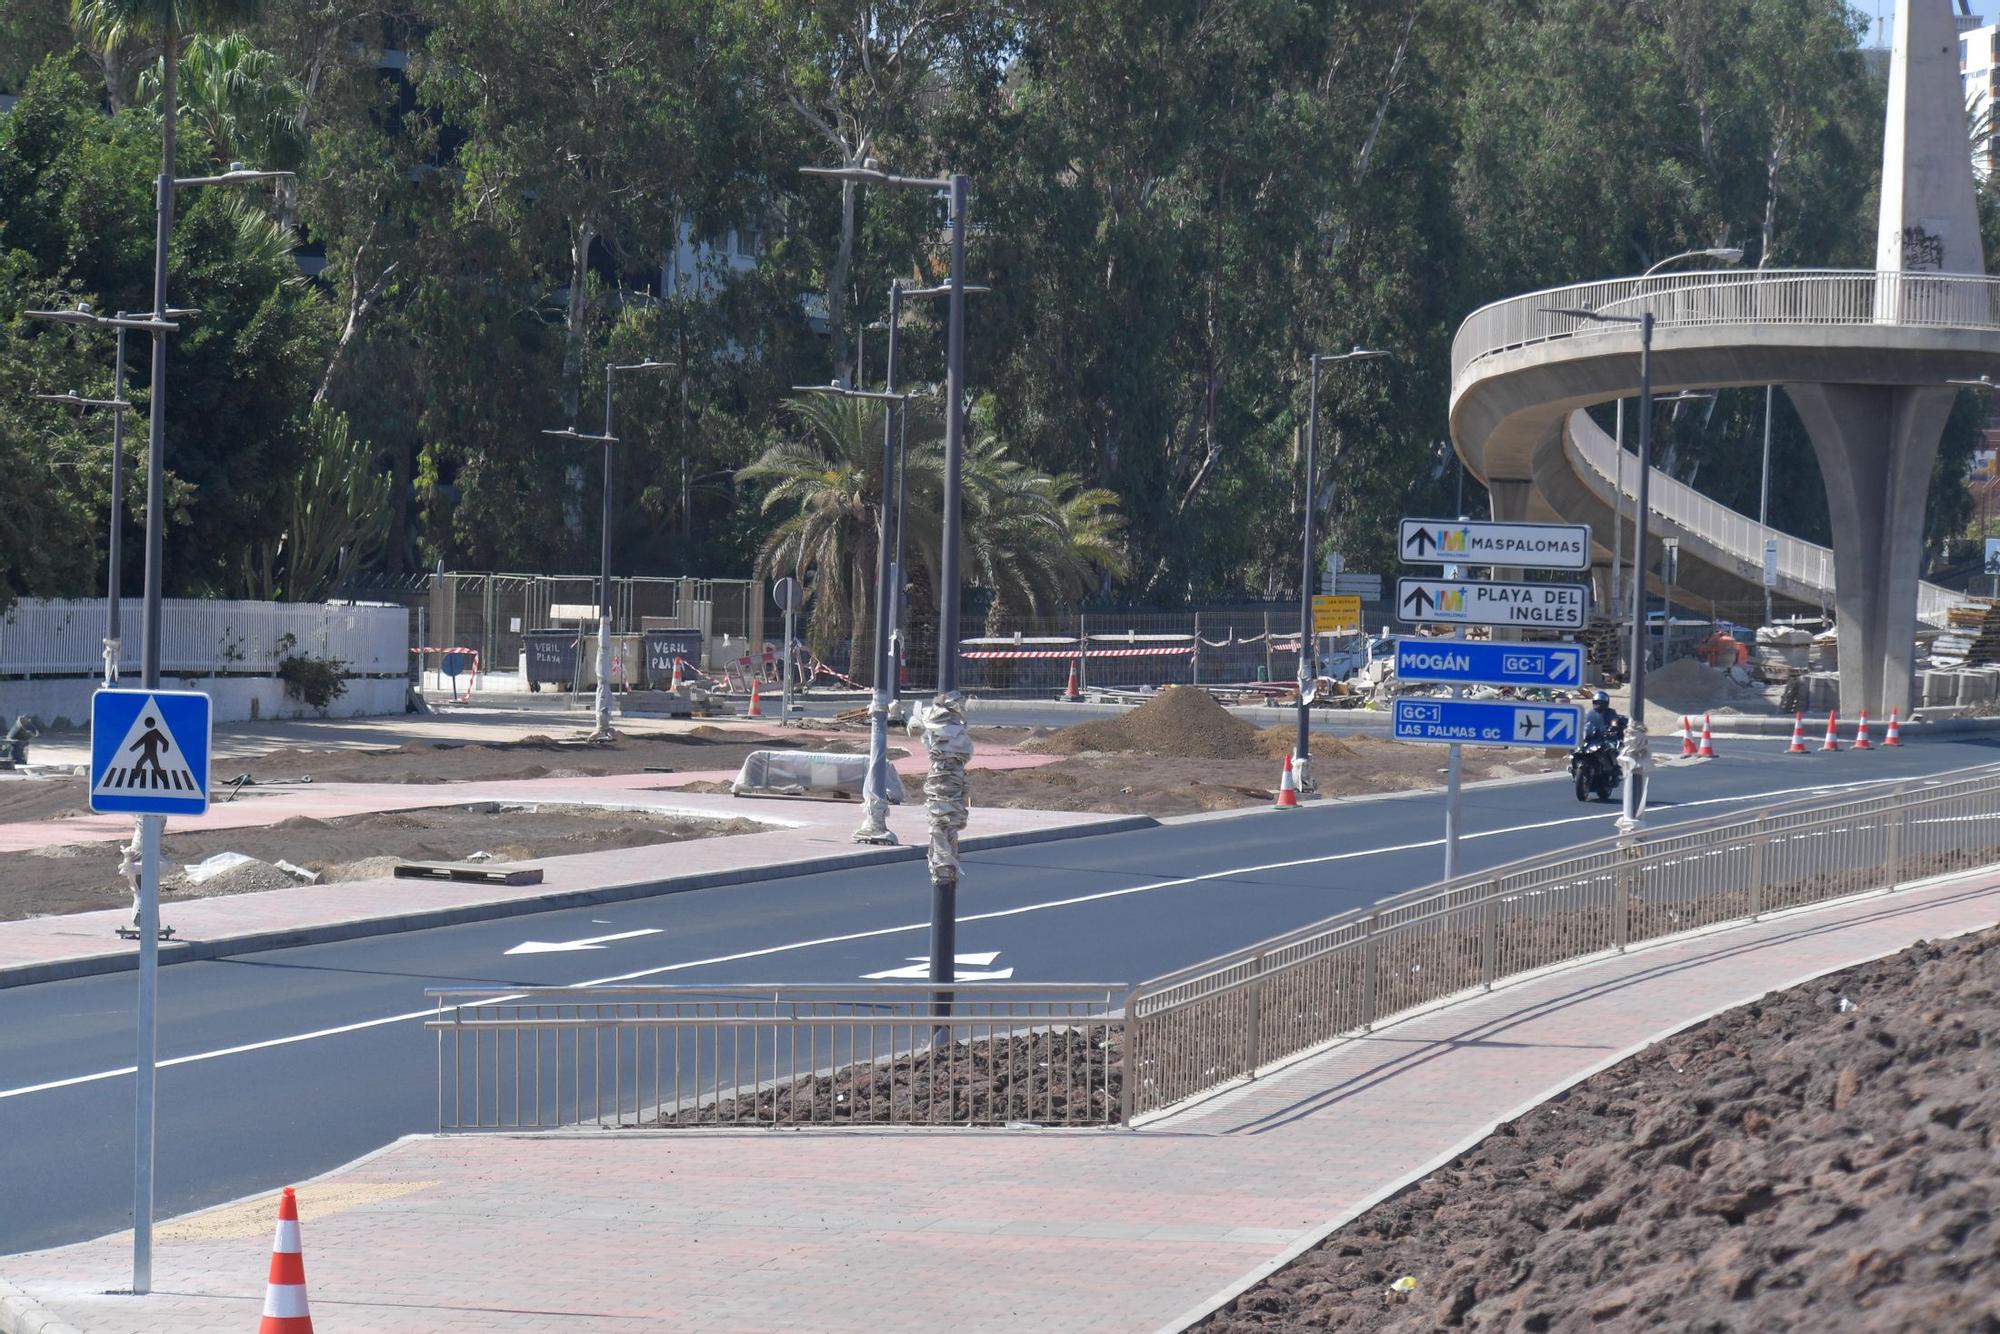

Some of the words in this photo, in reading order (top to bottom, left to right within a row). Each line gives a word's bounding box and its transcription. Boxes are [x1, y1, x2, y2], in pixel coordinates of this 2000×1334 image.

[1471, 537, 1581, 553] MASPALOMAS
[1477, 587, 1533, 603] PLAYA
[1545, 590, 1578, 605] DEL
[1510, 602, 1577, 622] INGLÉS
[535, 642, 560, 653] VERIL
[653, 641, 688, 654] VERIL
[1401, 652, 1470, 672] MOGÁN
[1506, 657, 1543, 671] GC-1
[1402, 706, 1439, 720] GC-1
[1398, 724, 1422, 735] LAS
[1427, 725, 1476, 738] PALMAS
[1482, 728, 1501, 740] GC
